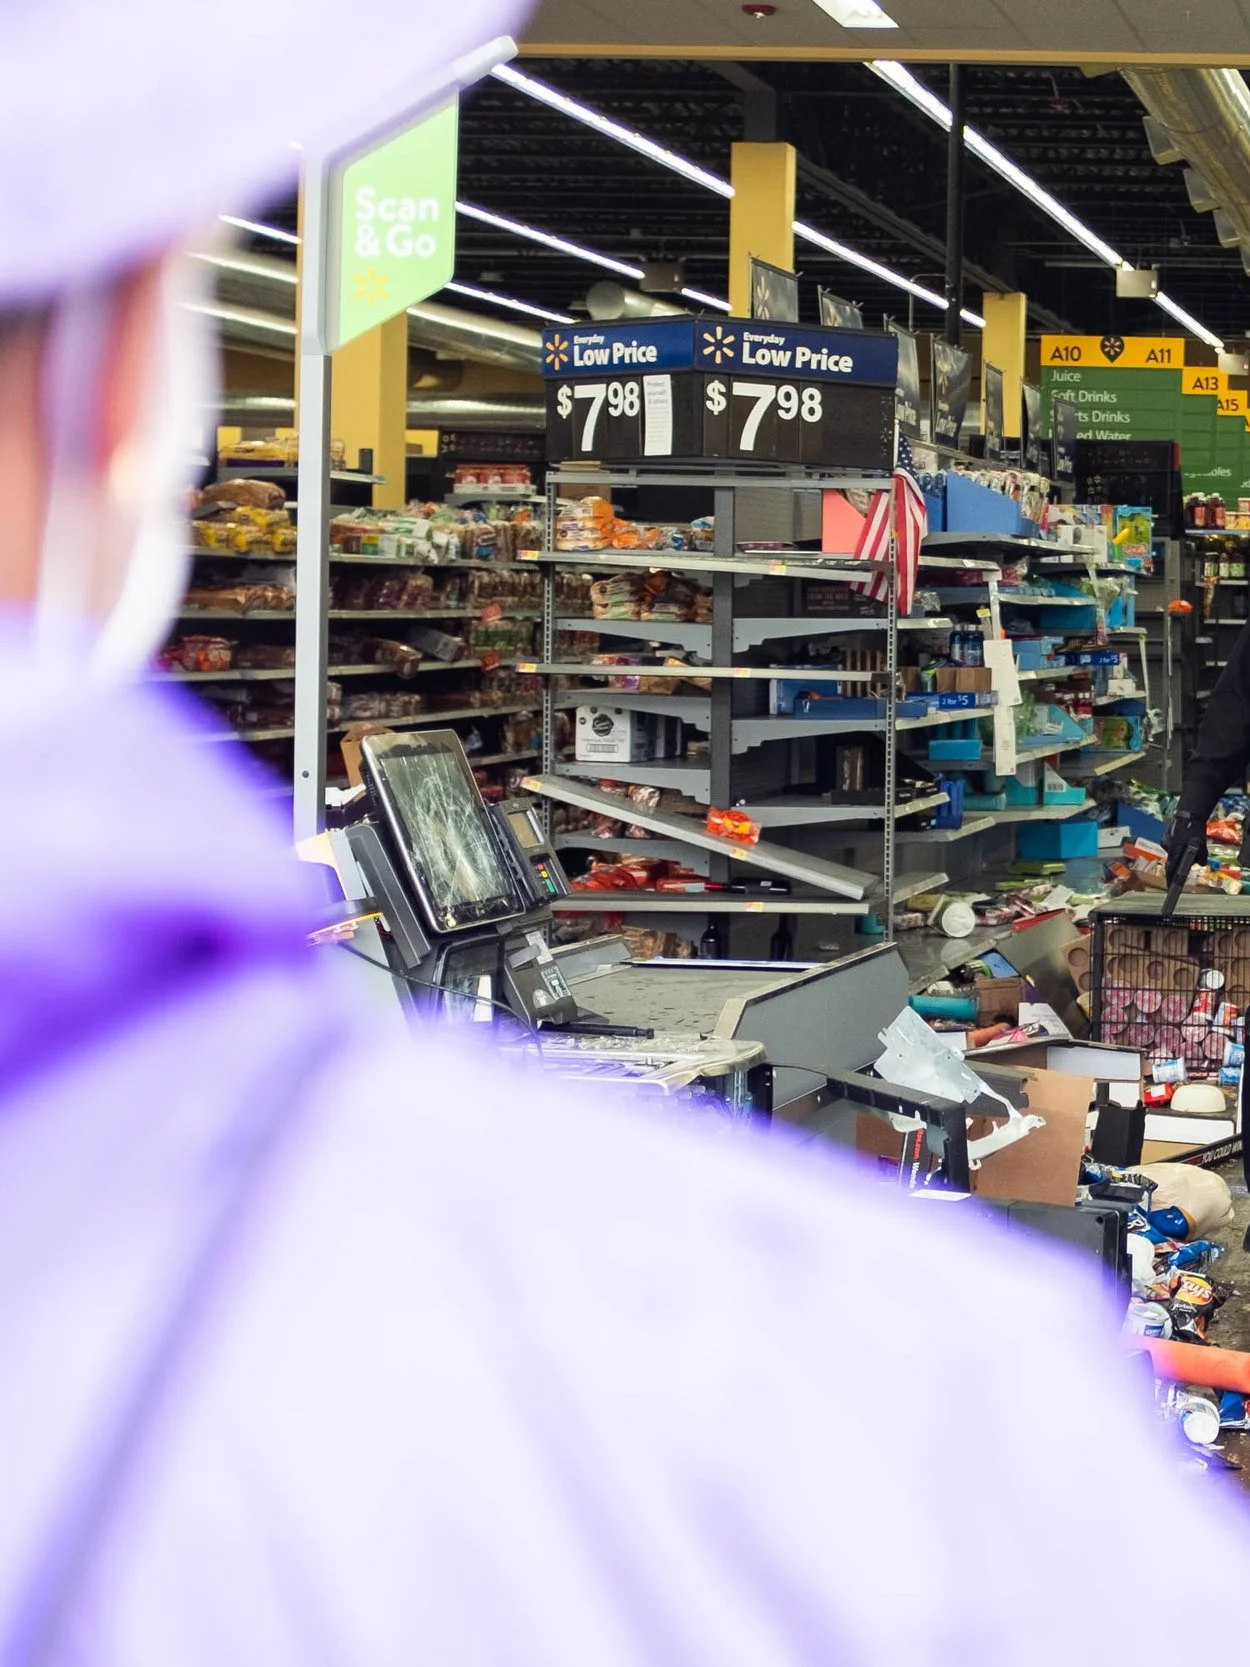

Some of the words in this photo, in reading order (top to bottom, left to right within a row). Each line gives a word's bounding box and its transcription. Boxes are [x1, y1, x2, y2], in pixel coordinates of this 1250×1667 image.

[355, 187, 439, 222] Scan
[355, 224, 381, 257] &
[386, 224, 437, 257] Go
[743, 332, 785, 346] Everyday
[573, 345, 610, 366] Low
[612, 340, 658, 364] Price
[742, 342, 791, 367] Low
[795, 347, 853, 373] Price
[1050, 346, 1082, 361] A10
[1145, 348, 1171, 363] A11
[1050, 370, 1082, 382] Juice
[1192, 376, 1219, 390] A13
[1079, 390, 1117, 403] Drinks
[1217, 399, 1239, 411] A15
[1092, 410, 1130, 423] Drinks
[1095, 430, 1131, 440] Water
